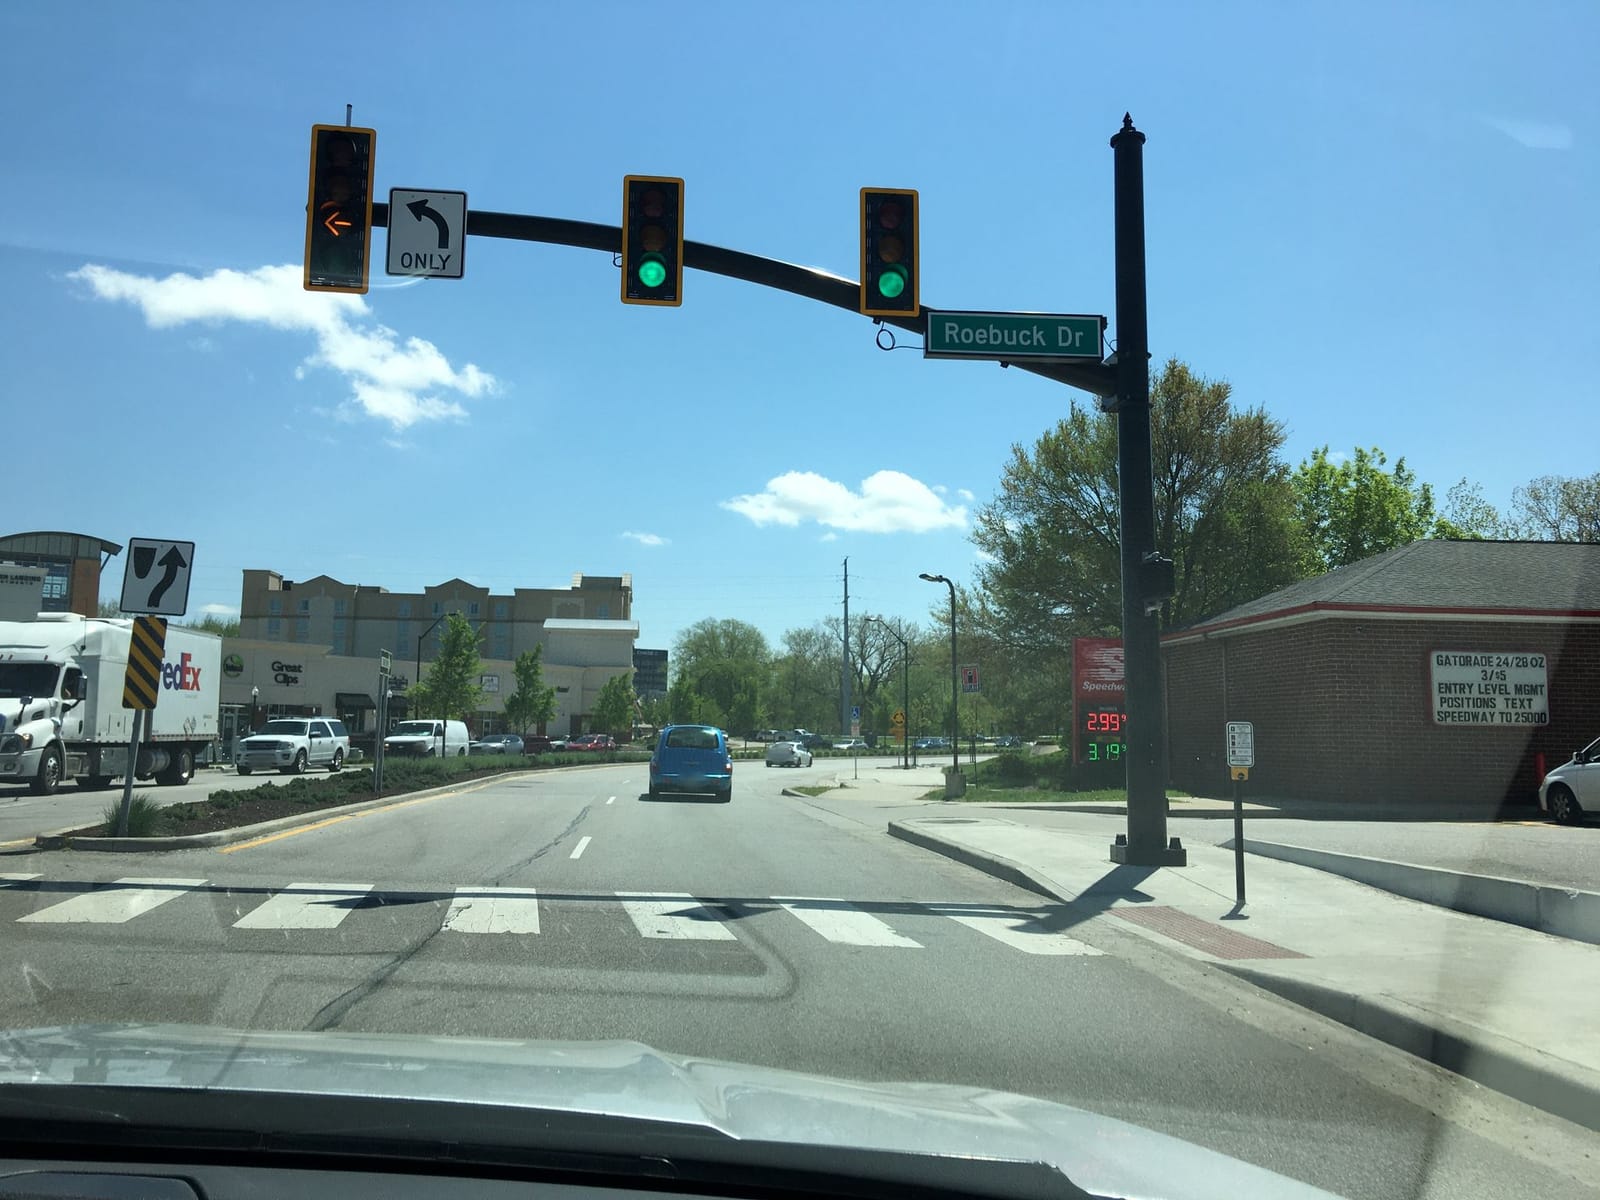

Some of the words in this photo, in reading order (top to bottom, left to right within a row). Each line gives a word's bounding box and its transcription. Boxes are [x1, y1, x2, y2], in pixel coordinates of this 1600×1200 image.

[400, 252, 451, 270] ONLY
[944, 322, 1046, 346] Roebuck
[1057, 326, 1083, 347] Dr
[271, 661, 303, 673] Great
[1436, 654, 1494, 667] GATORADE
[1495, 656, 1528, 667] 24/28
[1530, 656, 1545, 668] OZ
[274, 673, 299, 687] Clips
[1438, 683, 1474, 695] ENTRY
[1478, 684, 1511, 695] LEVEL
[1514, 684, 1545, 696] MGMT
[1440, 697, 1497, 709] POSITIONS
[1504, 697, 1533, 709] TEXT
[1437, 711, 1496, 723] SPEEDWAY
[1499, 712, 1512, 723] TO
